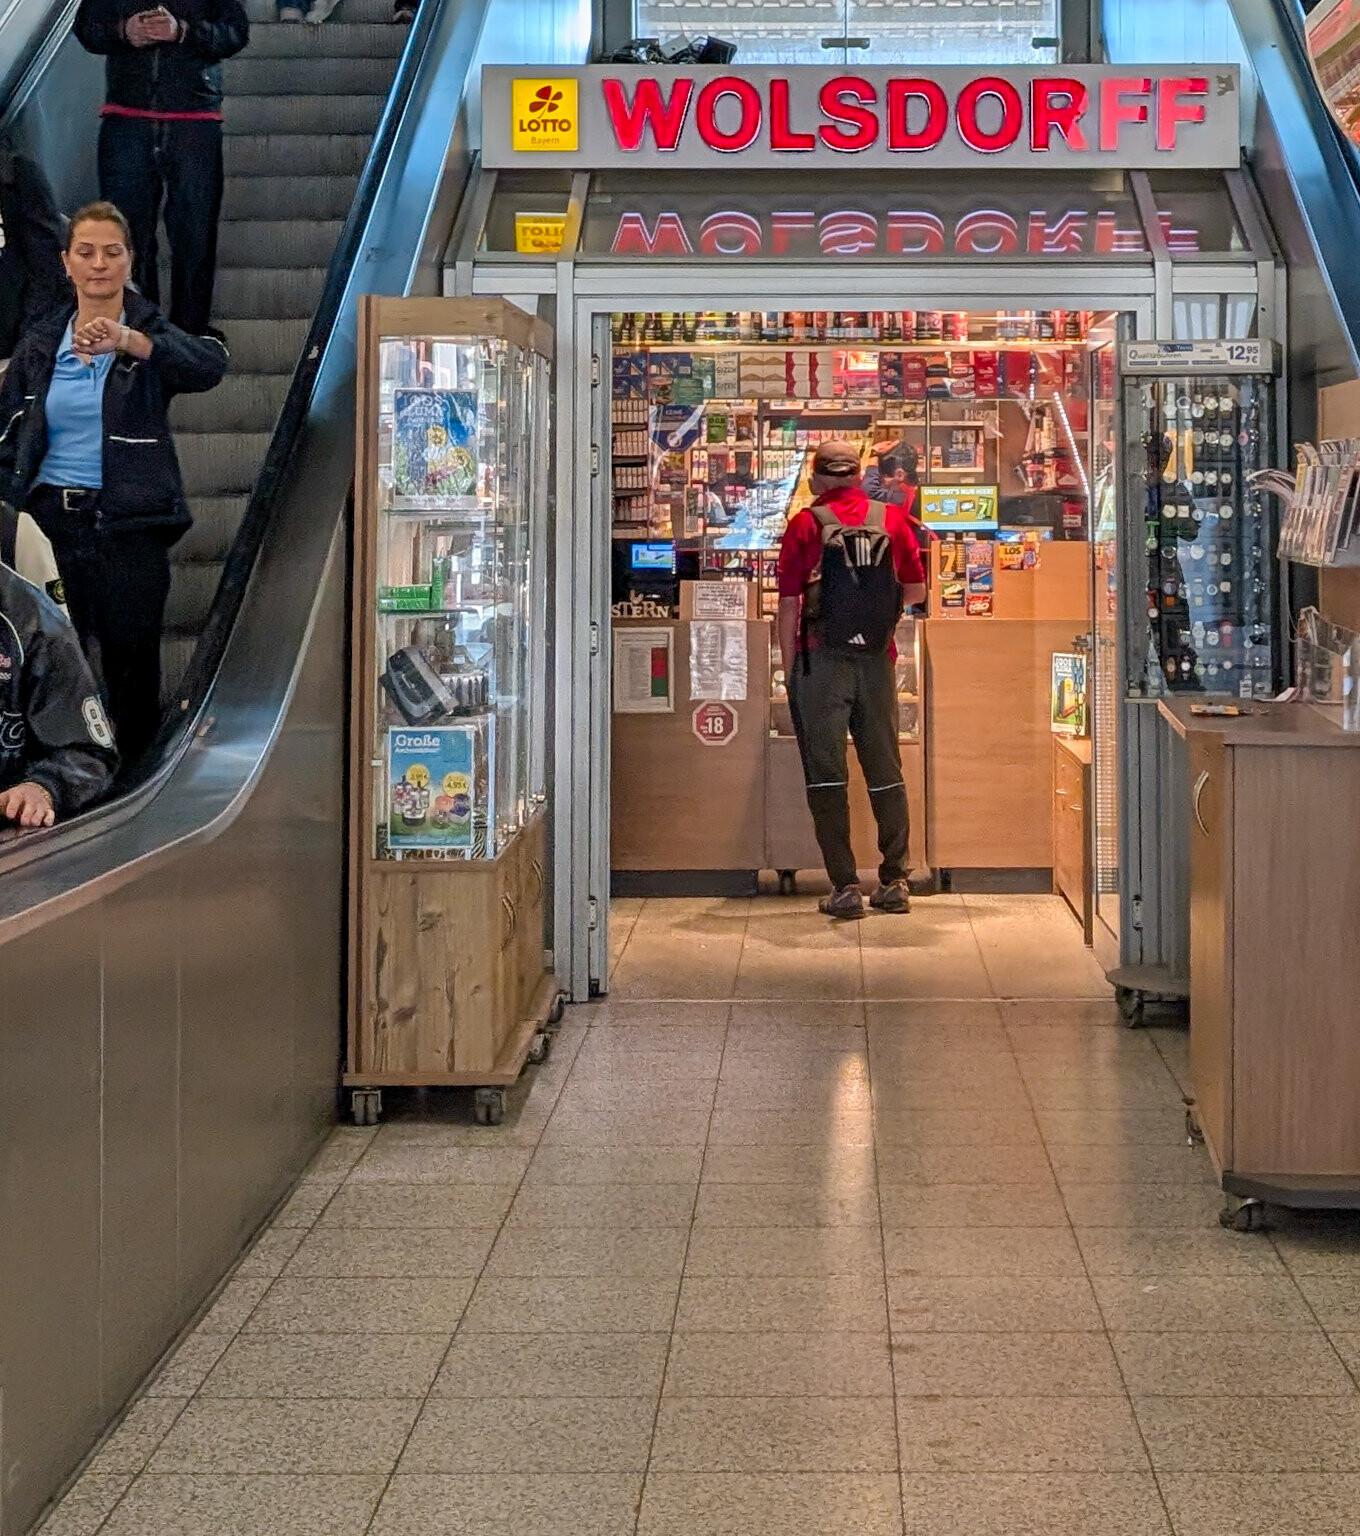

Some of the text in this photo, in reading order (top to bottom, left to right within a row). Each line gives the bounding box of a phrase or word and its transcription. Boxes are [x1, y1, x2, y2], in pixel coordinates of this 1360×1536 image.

[602, 76, 1210, 153] WOLSDORFF
[519, 118, 572, 132] LOTTO
[531, 137, 560, 145] Bayern
[395, 734, 441, 747] Große
